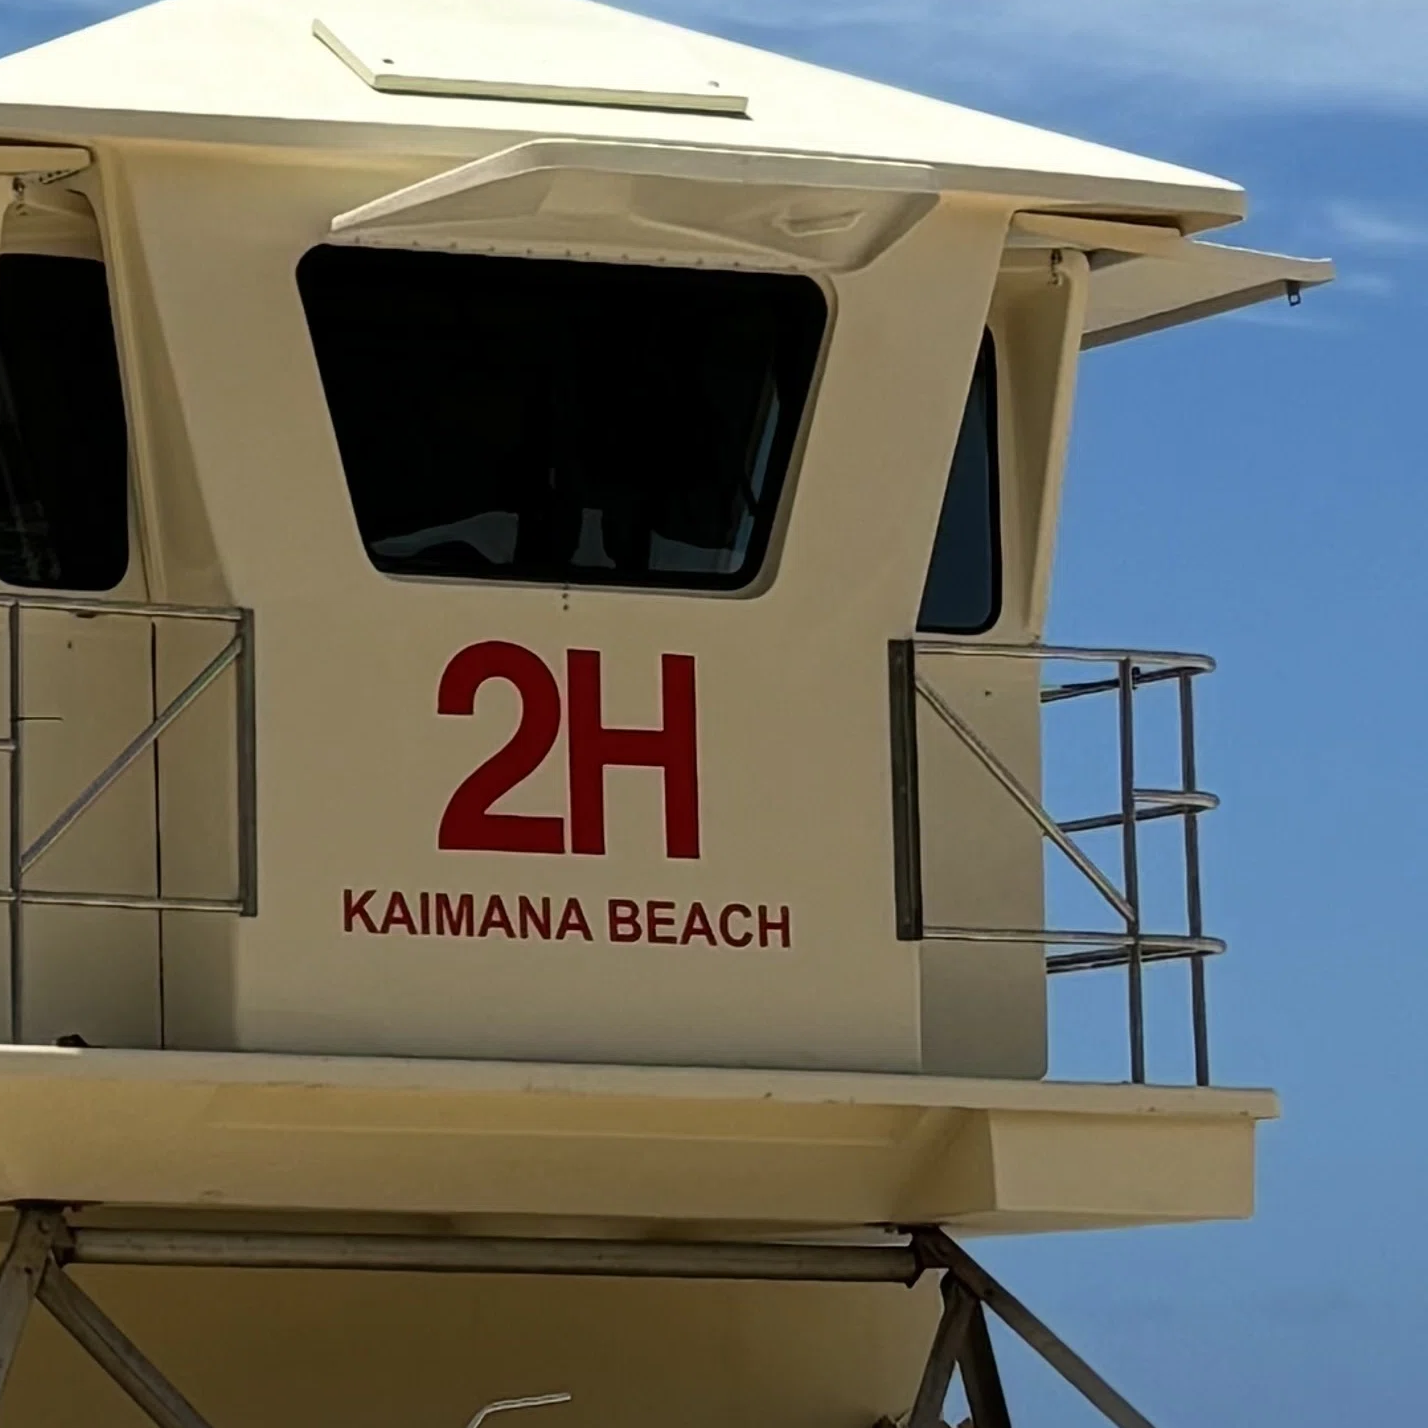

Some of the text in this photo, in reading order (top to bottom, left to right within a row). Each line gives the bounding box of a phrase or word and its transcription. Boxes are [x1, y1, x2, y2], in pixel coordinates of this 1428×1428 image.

[436, 640, 701, 859] 2H
[343, 888, 791, 948] KAIMANA BEACH
